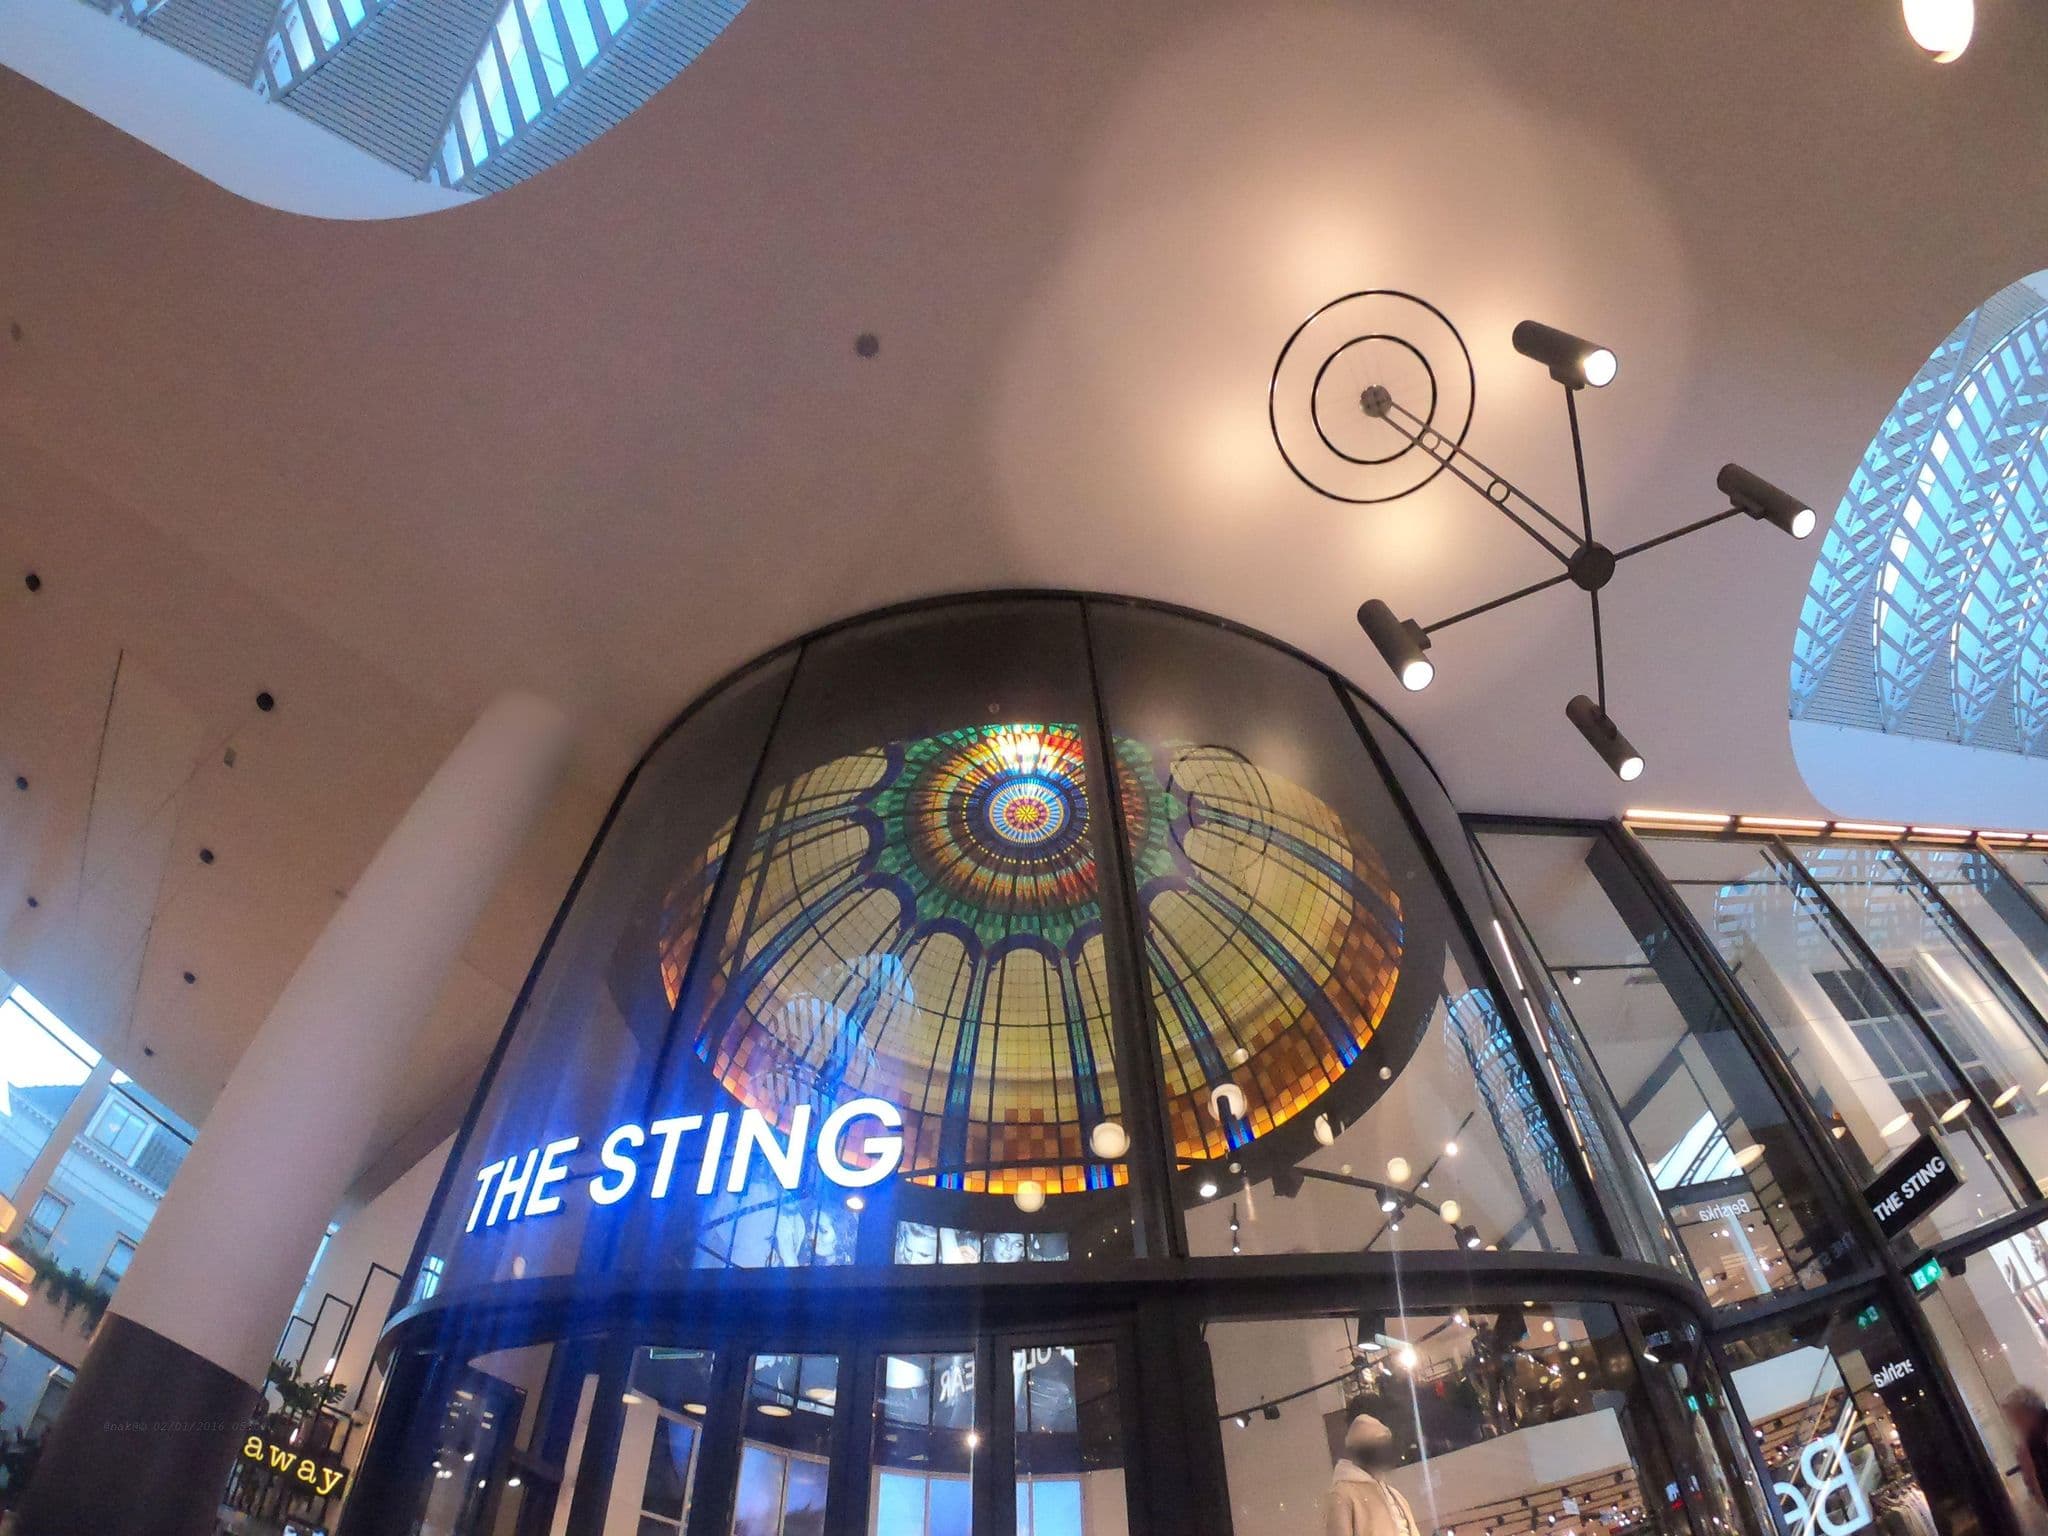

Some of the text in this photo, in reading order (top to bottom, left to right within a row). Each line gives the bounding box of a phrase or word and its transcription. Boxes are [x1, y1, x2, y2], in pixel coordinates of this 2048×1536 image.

[464, 1097, 904, 1233] THE STING
[1872, 1156, 1946, 1222] THE STING
[243, 1435, 345, 1496] away
